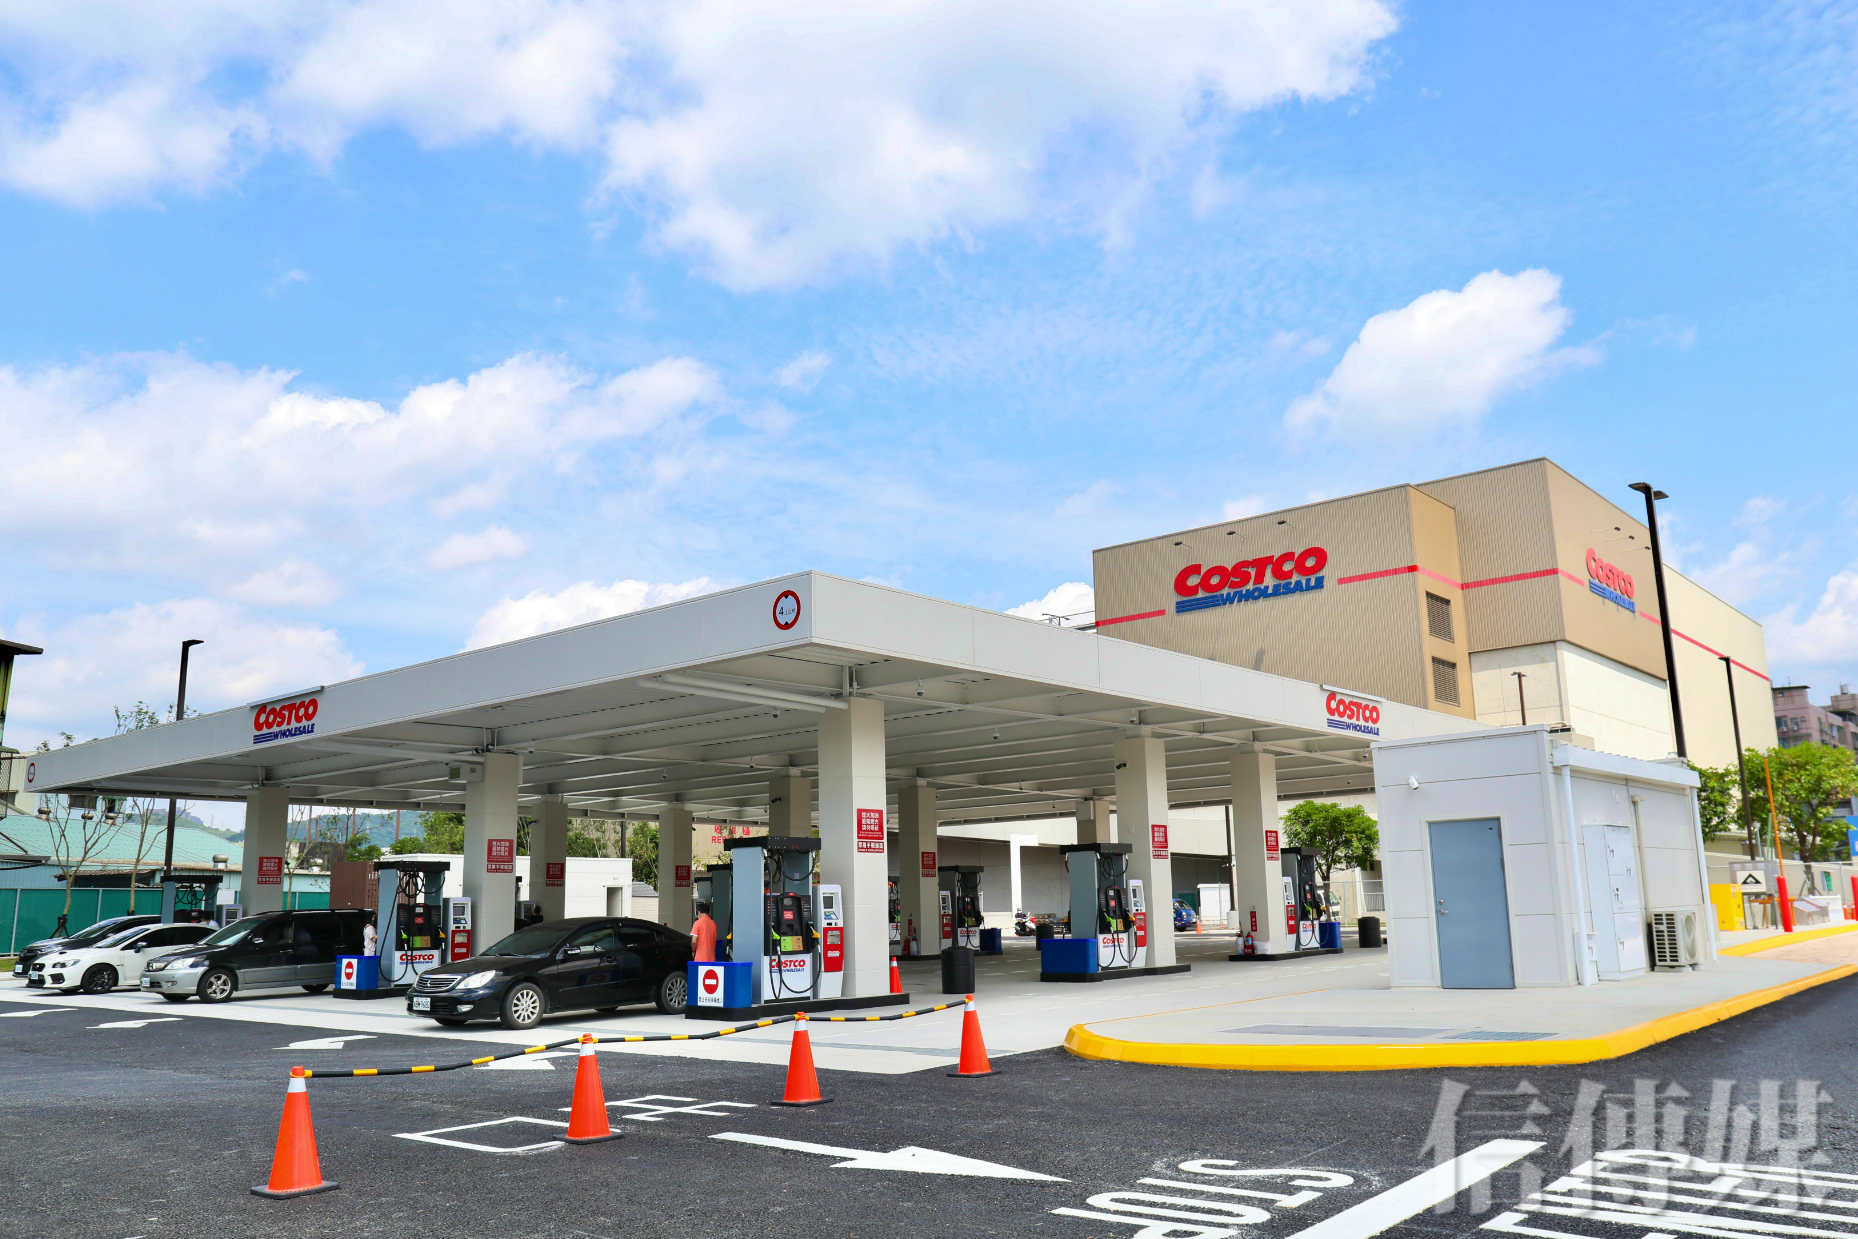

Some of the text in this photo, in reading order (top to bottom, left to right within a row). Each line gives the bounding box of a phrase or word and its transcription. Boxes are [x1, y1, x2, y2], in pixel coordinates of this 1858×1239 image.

[1174, 546, 1328, 597] COSTCO
[1586, 547, 1635, 599] COSTCO
[1219, 575, 1325, 606] WHOLESALE
[254, 698, 318, 732] COSTCO
[1326, 692, 1380, 725] COSTCO
[273, 723, 315, 740] WHOLESALE
[1345, 721, 1380, 736] WHOLESALE
[1050, 1159, 1355, 1239] STOP
